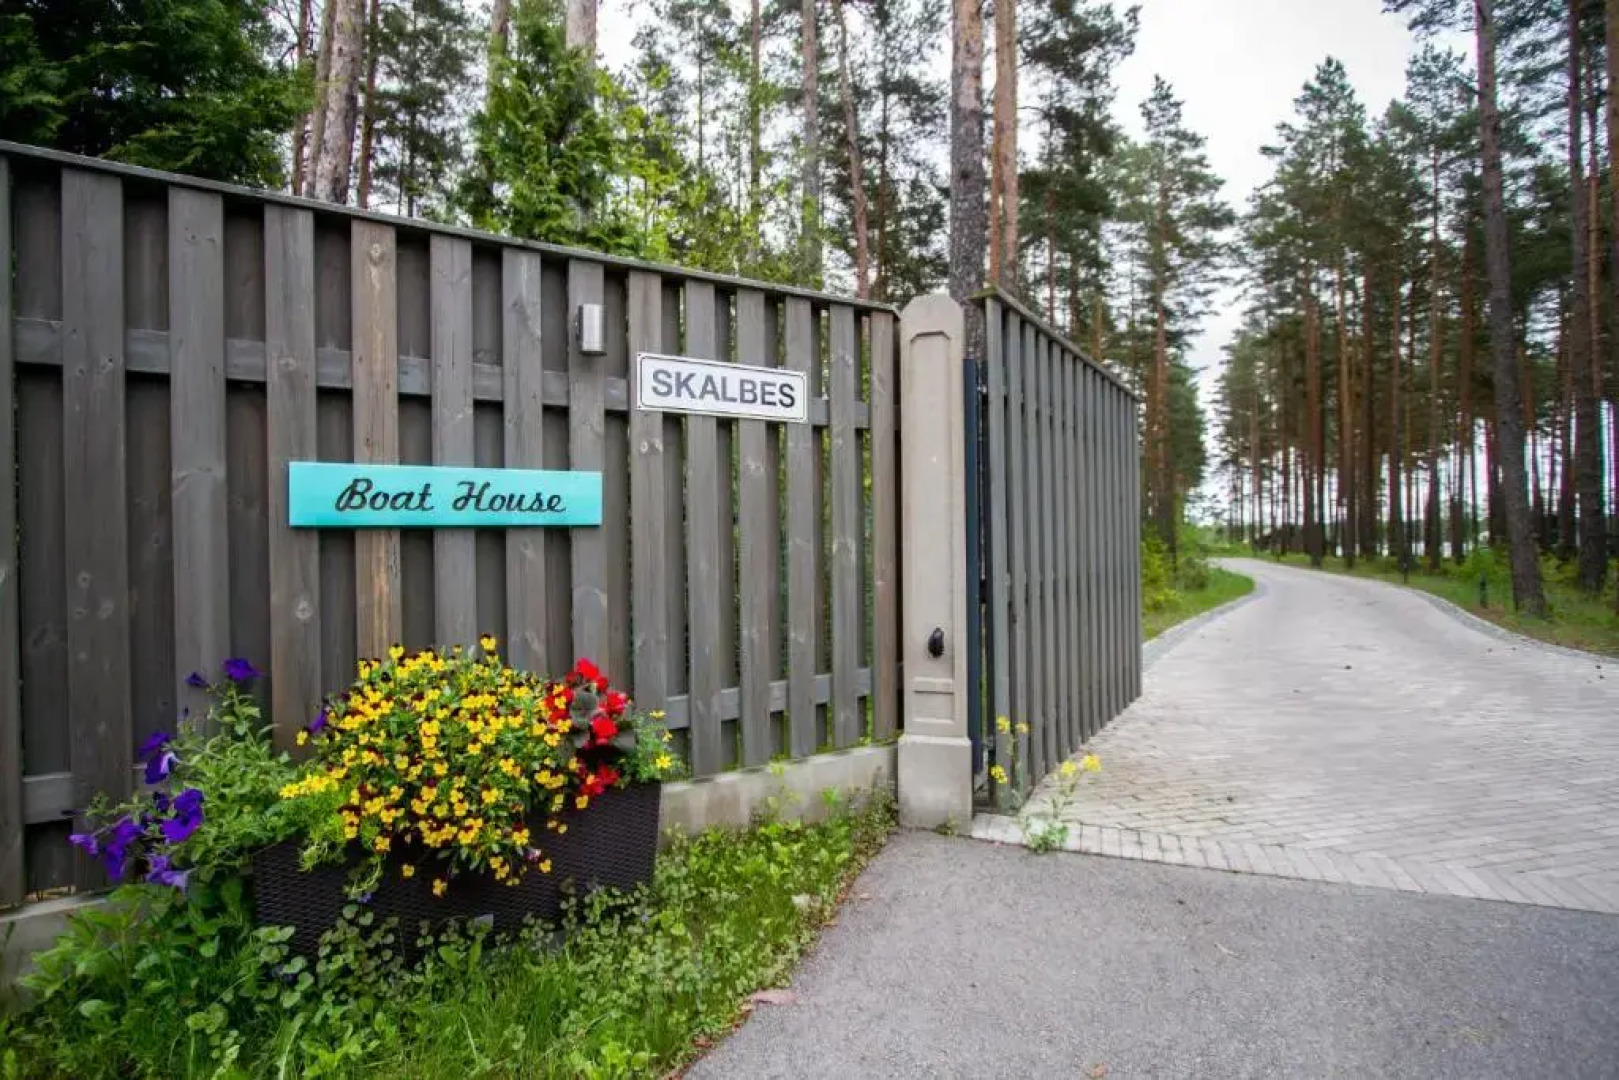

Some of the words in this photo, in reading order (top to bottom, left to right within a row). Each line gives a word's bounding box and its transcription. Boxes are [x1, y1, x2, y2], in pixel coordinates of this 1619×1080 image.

[652, 369, 796, 409] SKALBES
[334, 478, 435, 512] Boat
[452, 480, 567, 513] House
